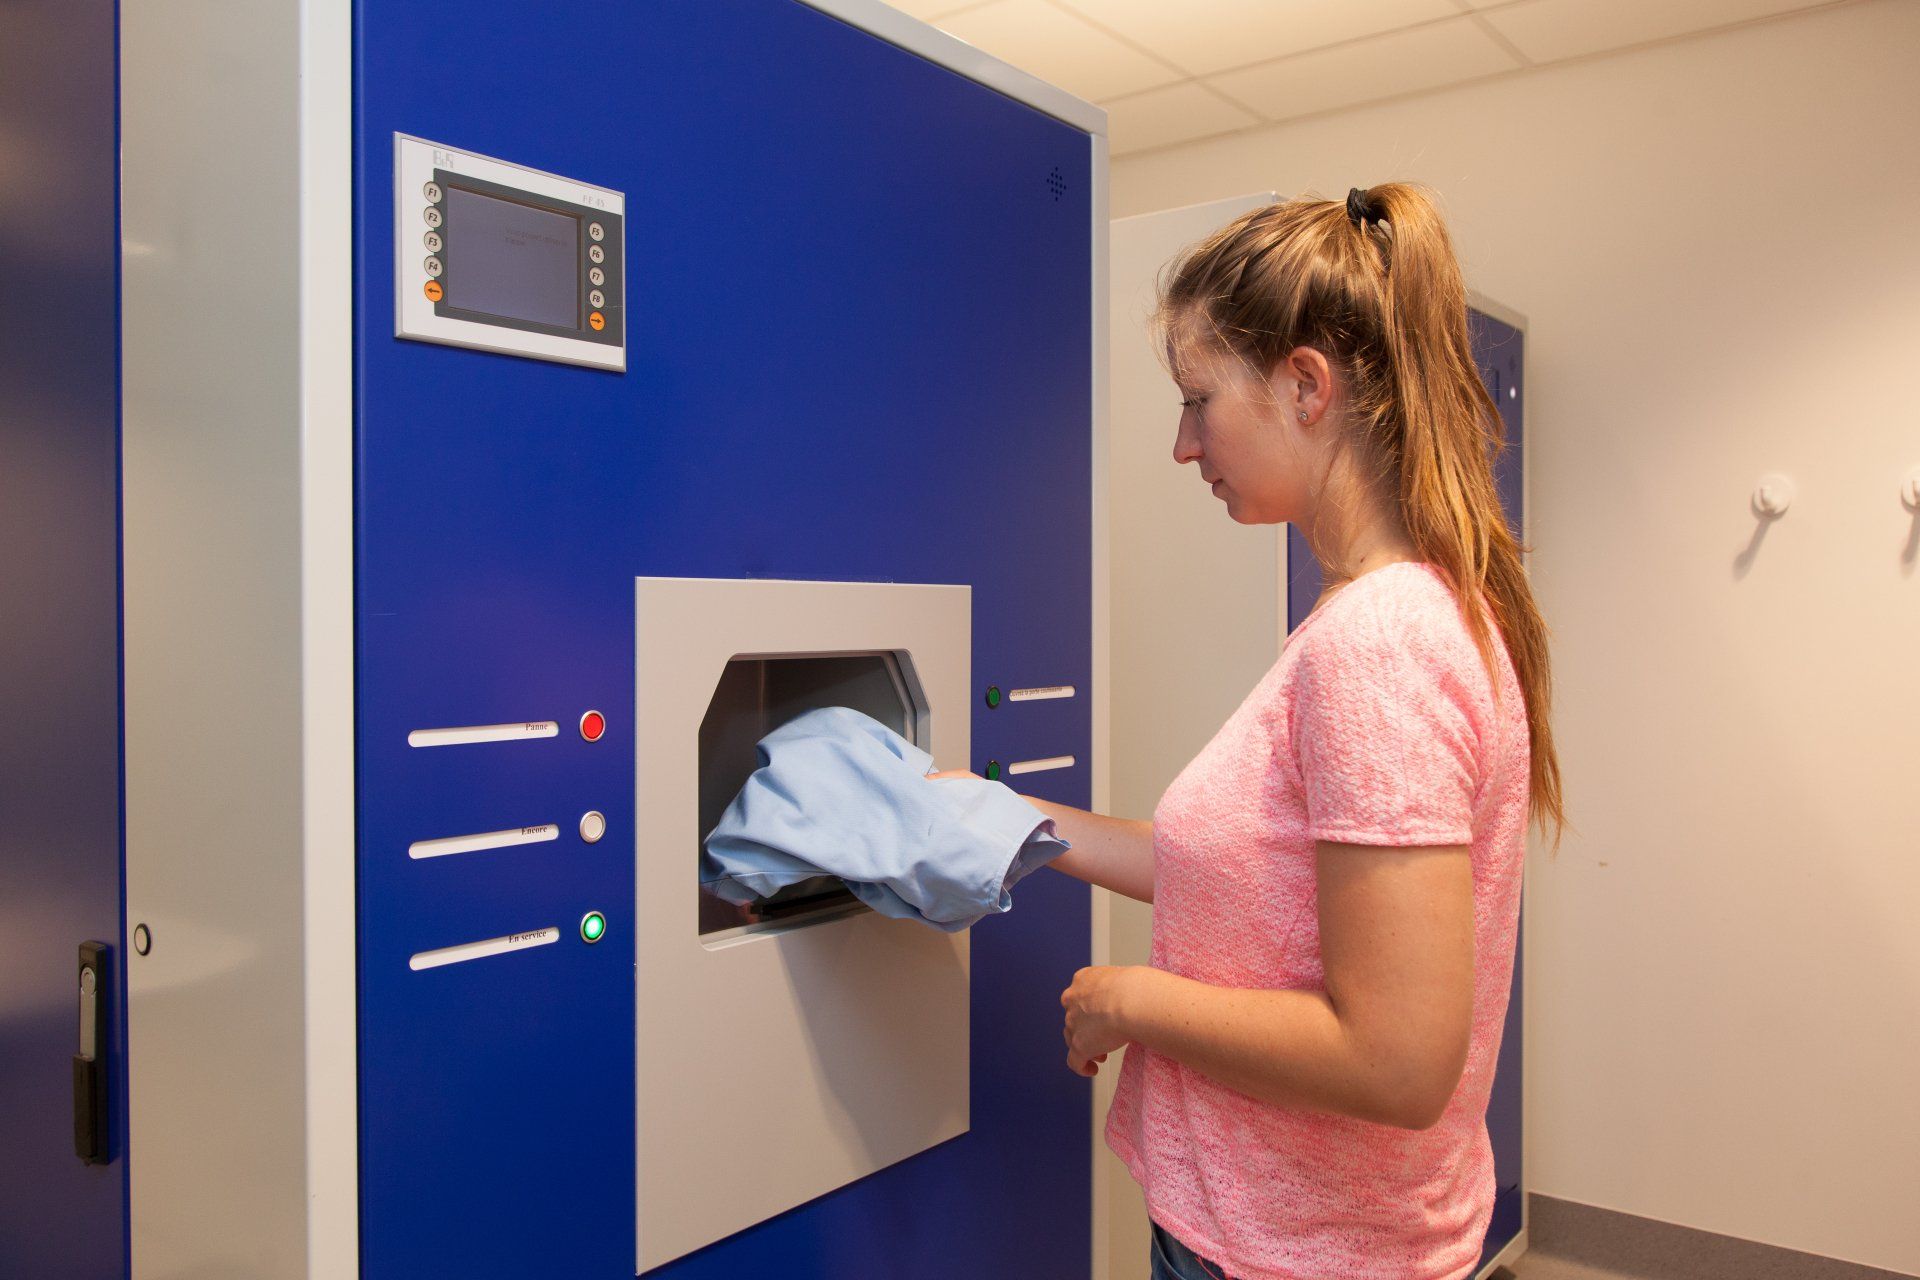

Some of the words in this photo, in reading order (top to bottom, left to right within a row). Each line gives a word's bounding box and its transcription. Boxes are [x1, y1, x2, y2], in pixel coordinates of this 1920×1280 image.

[428, 187, 437, 198] F1
[428, 212, 438, 223] F2
[591, 227, 600, 236] F5
[428, 237, 438, 247] F3
[592, 249, 601, 259] F6
[428, 261, 438, 272] F4
[592, 271, 601, 281] F7
[592, 294, 601, 303] F8
[525, 722, 547, 731] Panne
[521, 826, 548, 835] Encore
[509, 934, 519, 943] En
[521, 930, 547, 940] service
